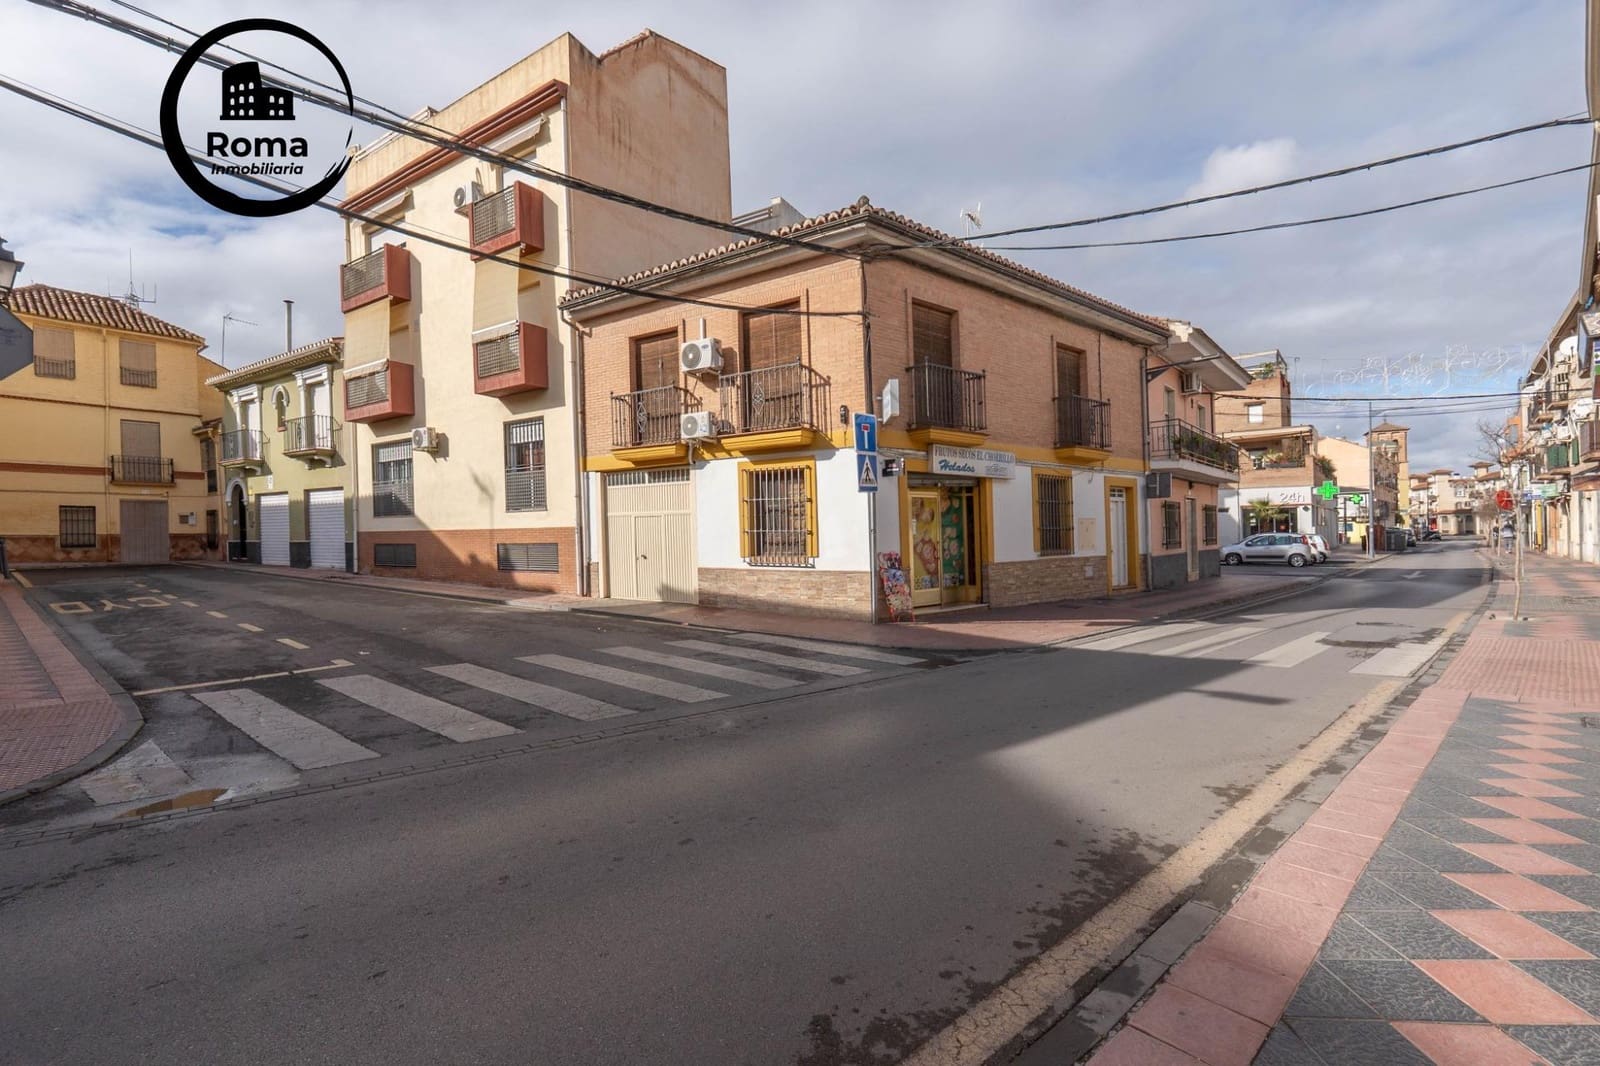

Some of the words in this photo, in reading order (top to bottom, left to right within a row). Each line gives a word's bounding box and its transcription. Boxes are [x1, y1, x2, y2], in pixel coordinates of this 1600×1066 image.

[935, 446, 958, 458] FRUTOS
[958, 447, 976, 459] SECOS
[938, 459, 976, 473] Helados
[1279, 491, 1305, 503] 24h
